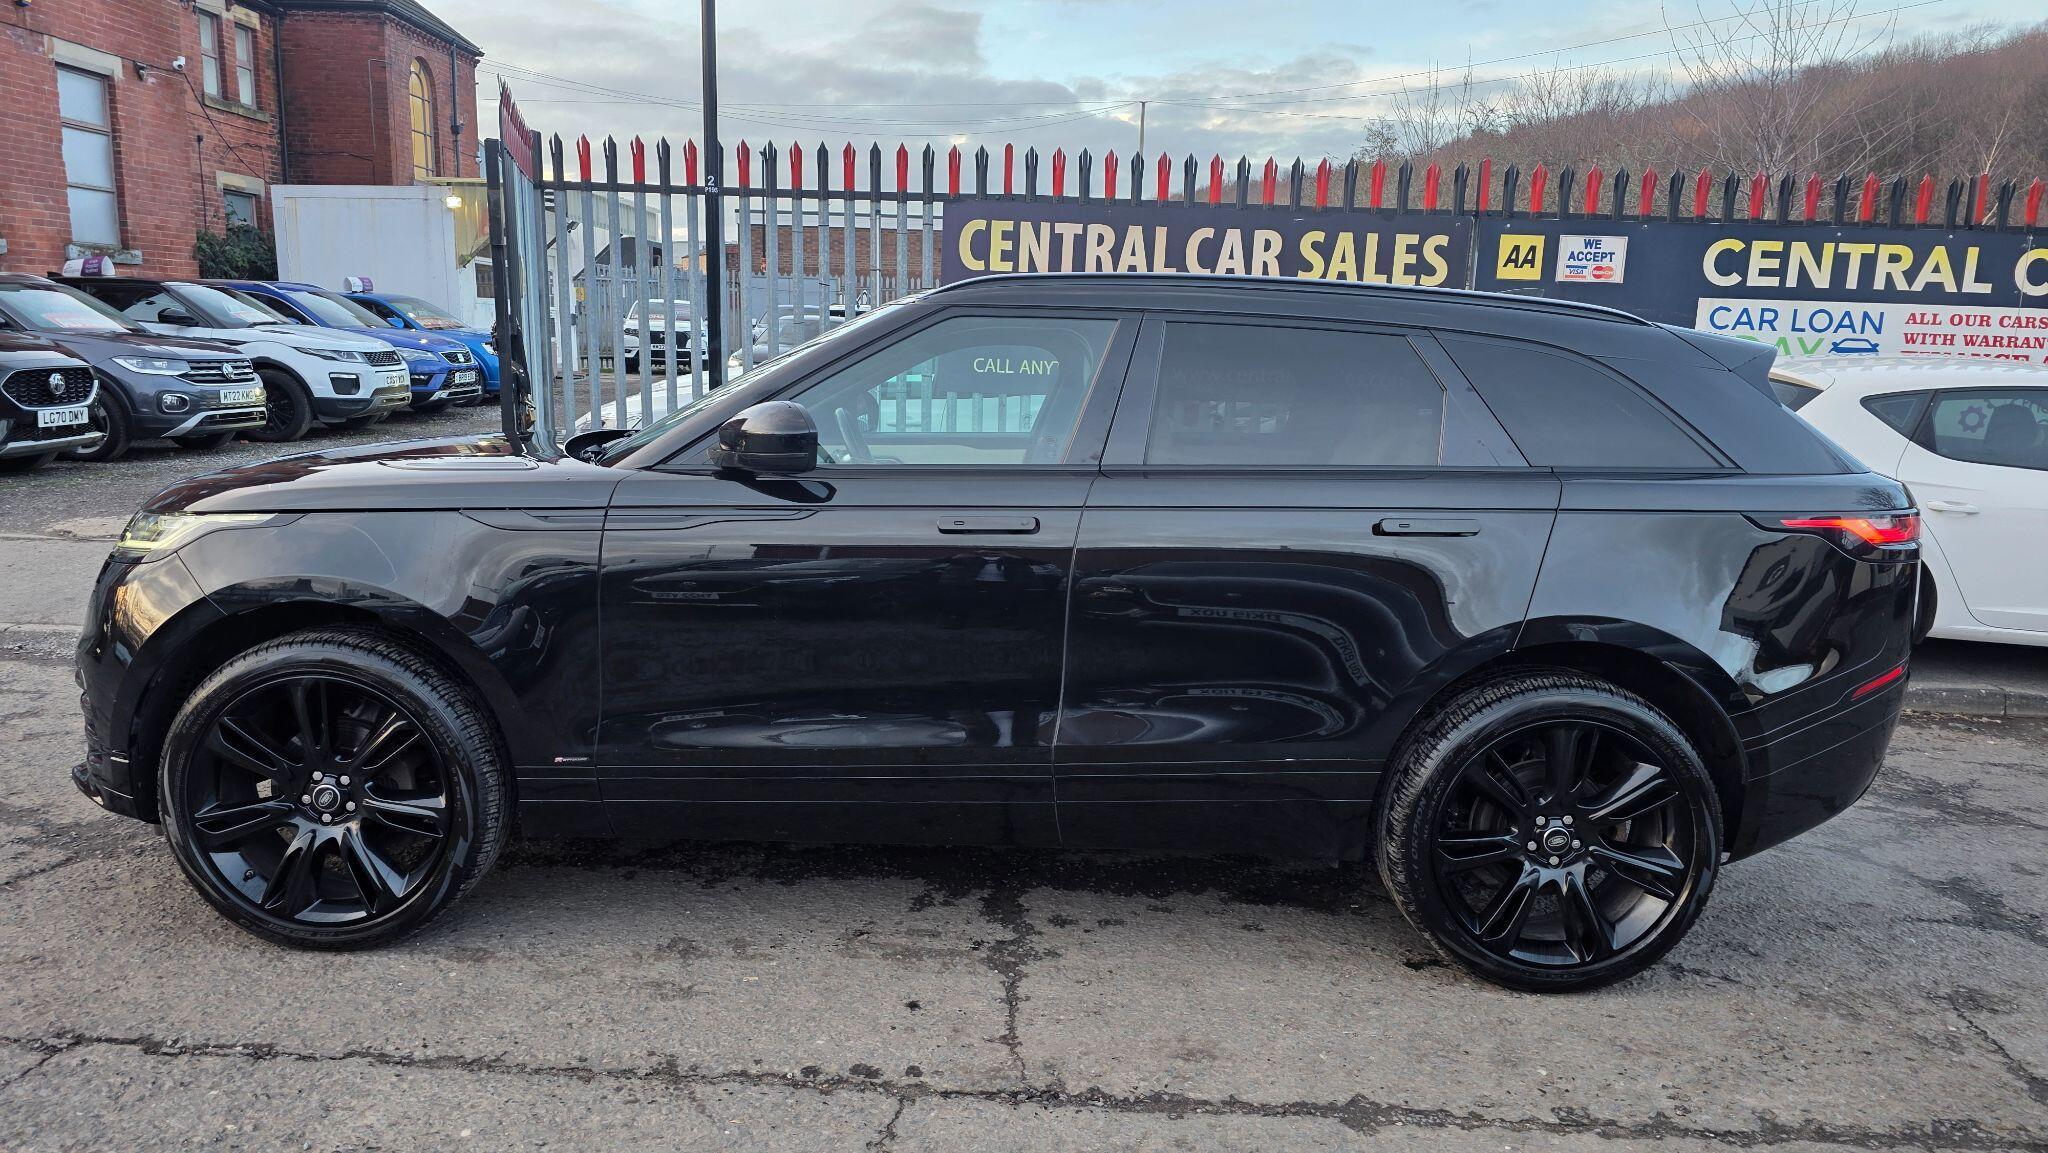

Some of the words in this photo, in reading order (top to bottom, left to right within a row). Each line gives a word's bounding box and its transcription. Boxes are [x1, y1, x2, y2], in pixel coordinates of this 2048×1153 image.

[707, 175, 715, 186] 2
[1584, 239, 1602, 249] WE
[959, 219, 1177, 273] CENTRAL
[1185, 227, 1283, 277] CAR
[1297, 230, 1450, 287] SALES
[1502, 245, 1537, 268] AA
[1567, 251, 1615, 262] ACCEPT
[1703, 239, 1993, 294] CENTRAL
[1709, 306, 1778, 331] CAR
[1791, 309, 1884, 334] LOAN
[1905, 312, 1942, 326] ALL
[1949, 314, 1992, 327] OUR
[1999, 316, 2048, 329] CARS
[1903, 332, 1956, 346] WITH
[1963, 334, 2048, 349] WARRAN
[973, 358, 1014, 374] CALL
[69, 409, 85, 422] DMY
